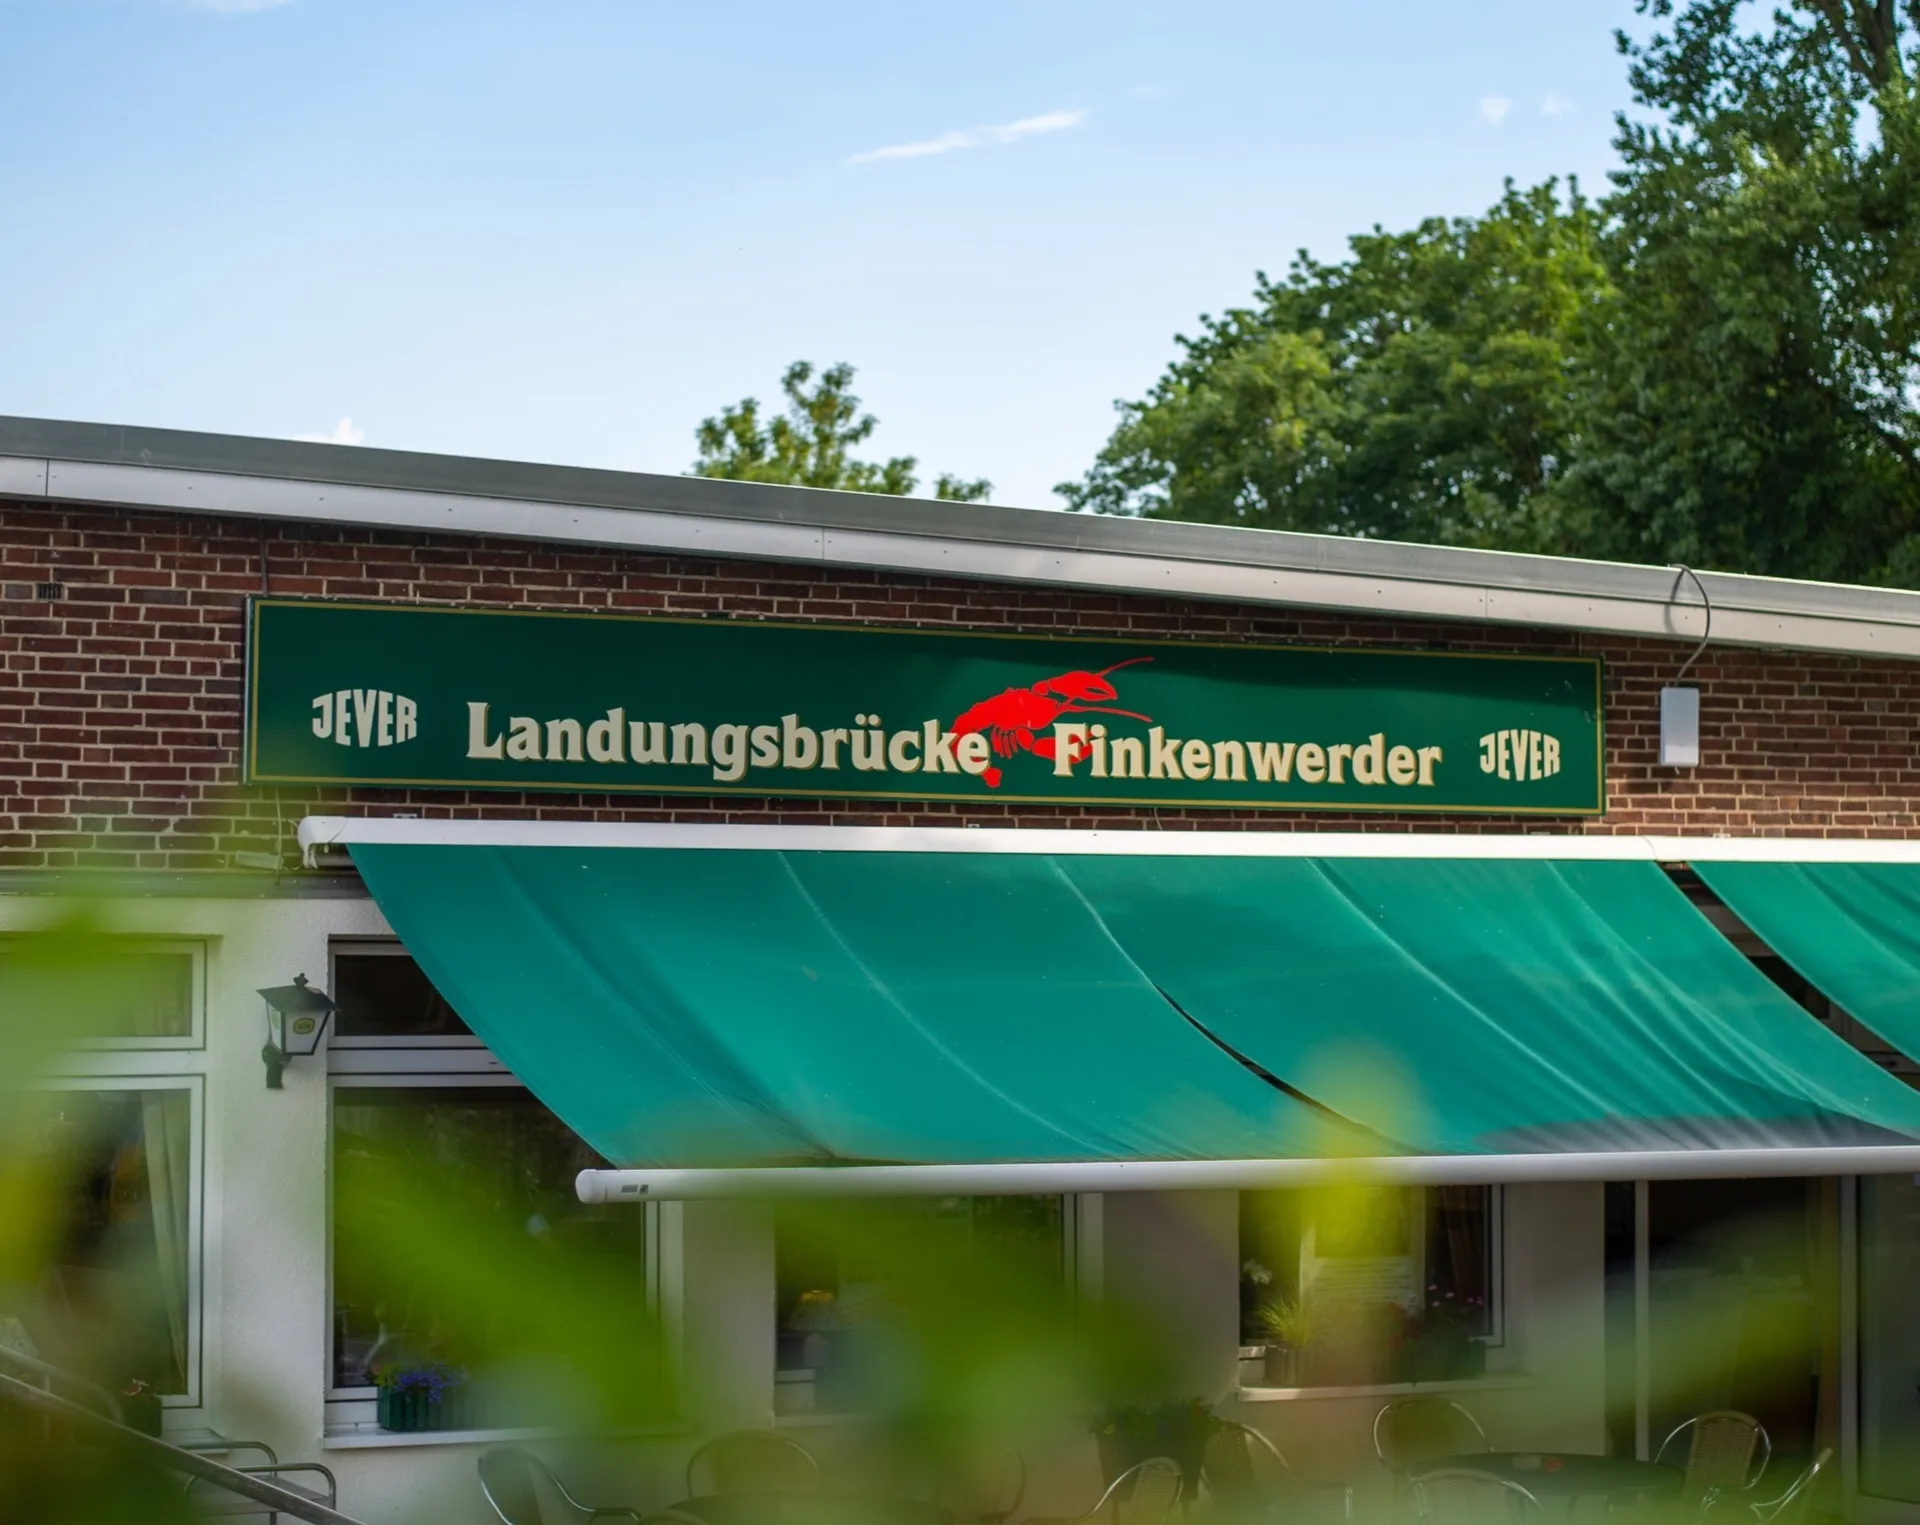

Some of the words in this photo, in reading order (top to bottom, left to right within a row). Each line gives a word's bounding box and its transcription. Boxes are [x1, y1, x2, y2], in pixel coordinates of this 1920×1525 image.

[312, 688, 417, 747] JEVER
[466, 701, 990, 782] Landungsbrücke
[1053, 723, 1442, 786] Finkenwerder
[1479, 729, 1561, 782] JEVER
